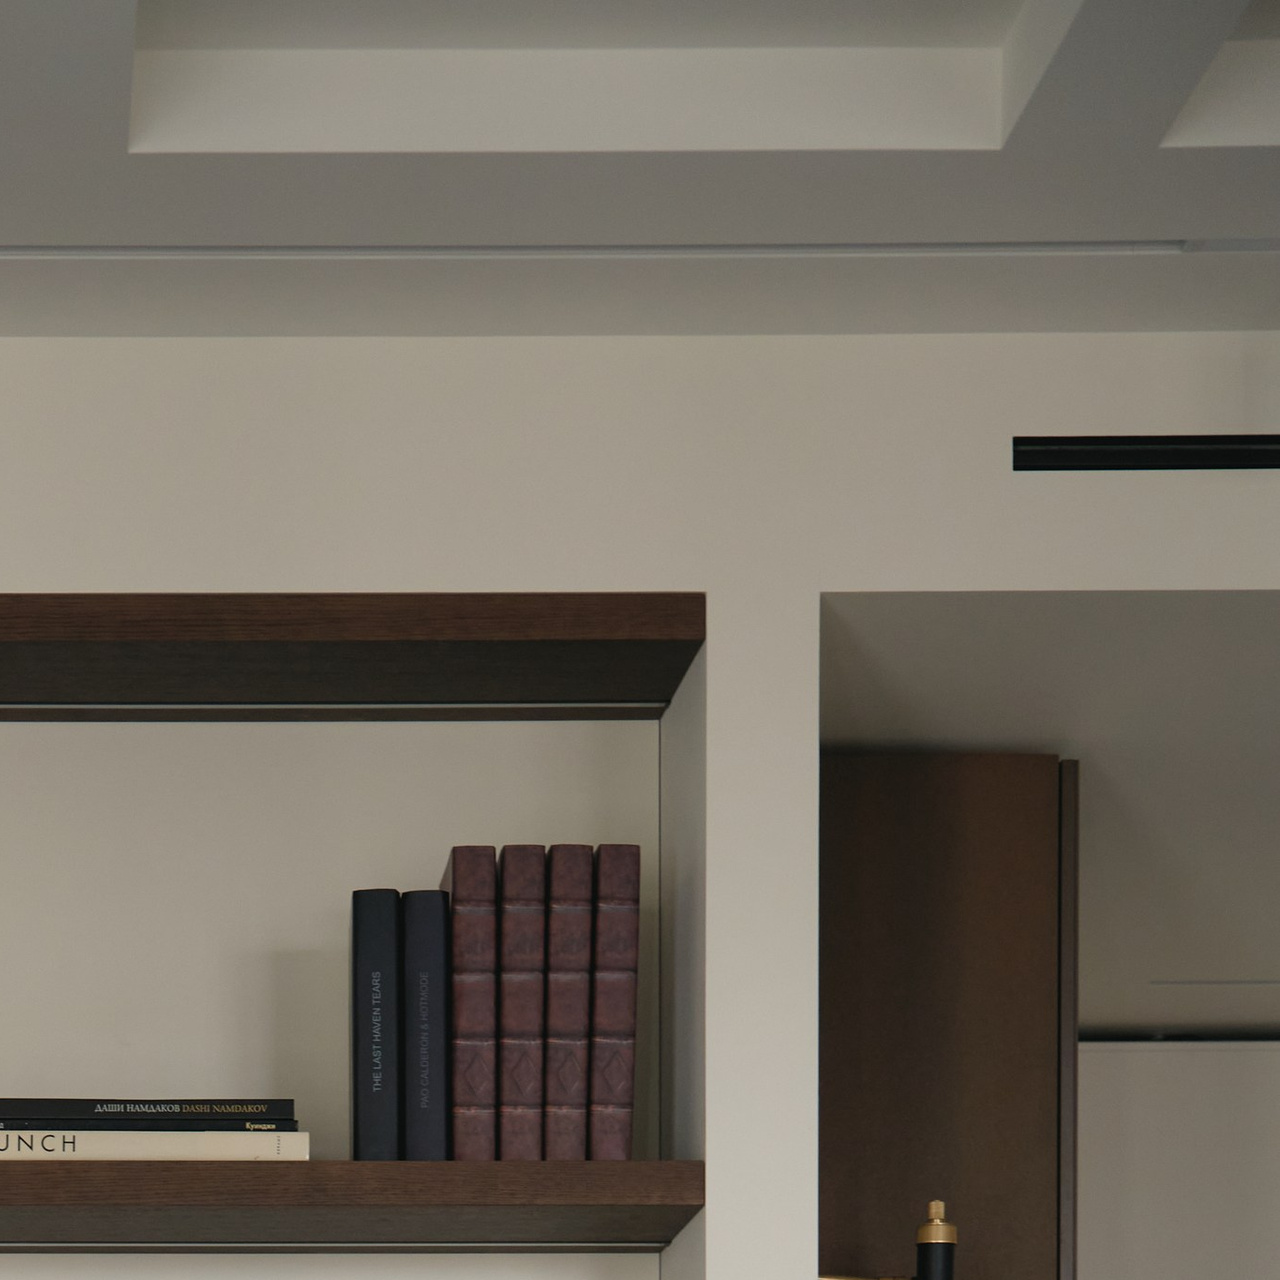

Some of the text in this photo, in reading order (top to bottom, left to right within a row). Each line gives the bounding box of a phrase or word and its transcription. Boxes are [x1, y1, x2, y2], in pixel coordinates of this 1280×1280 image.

[419, 971, 429, 1021] HOTMODE
[371, 971, 382, 1092] THE LAST HAVEN TEARS
[419, 1032, 430, 1087] CALDERON
[94, 1103, 181, 1113] ДАШИ НАМДАКОВ
[182, 1104, 268, 1113] DASHI NAMDAKOV
